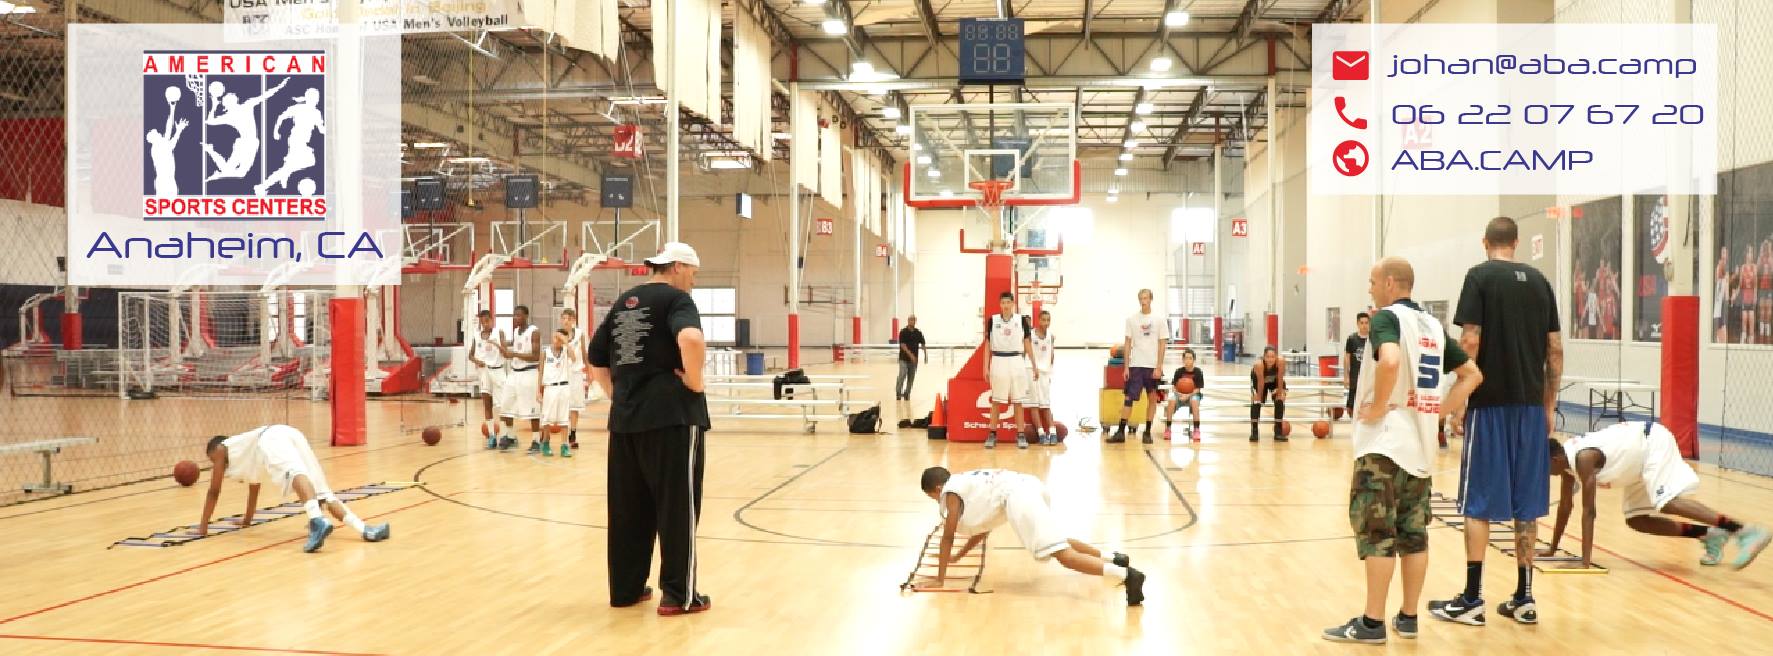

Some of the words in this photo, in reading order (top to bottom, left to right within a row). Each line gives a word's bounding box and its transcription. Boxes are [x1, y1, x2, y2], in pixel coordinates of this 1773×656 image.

[402, 17, 441, 29] Men's
[446, 14, 508, 28] Volleyball
[1417, 353, 1441, 388] 5
